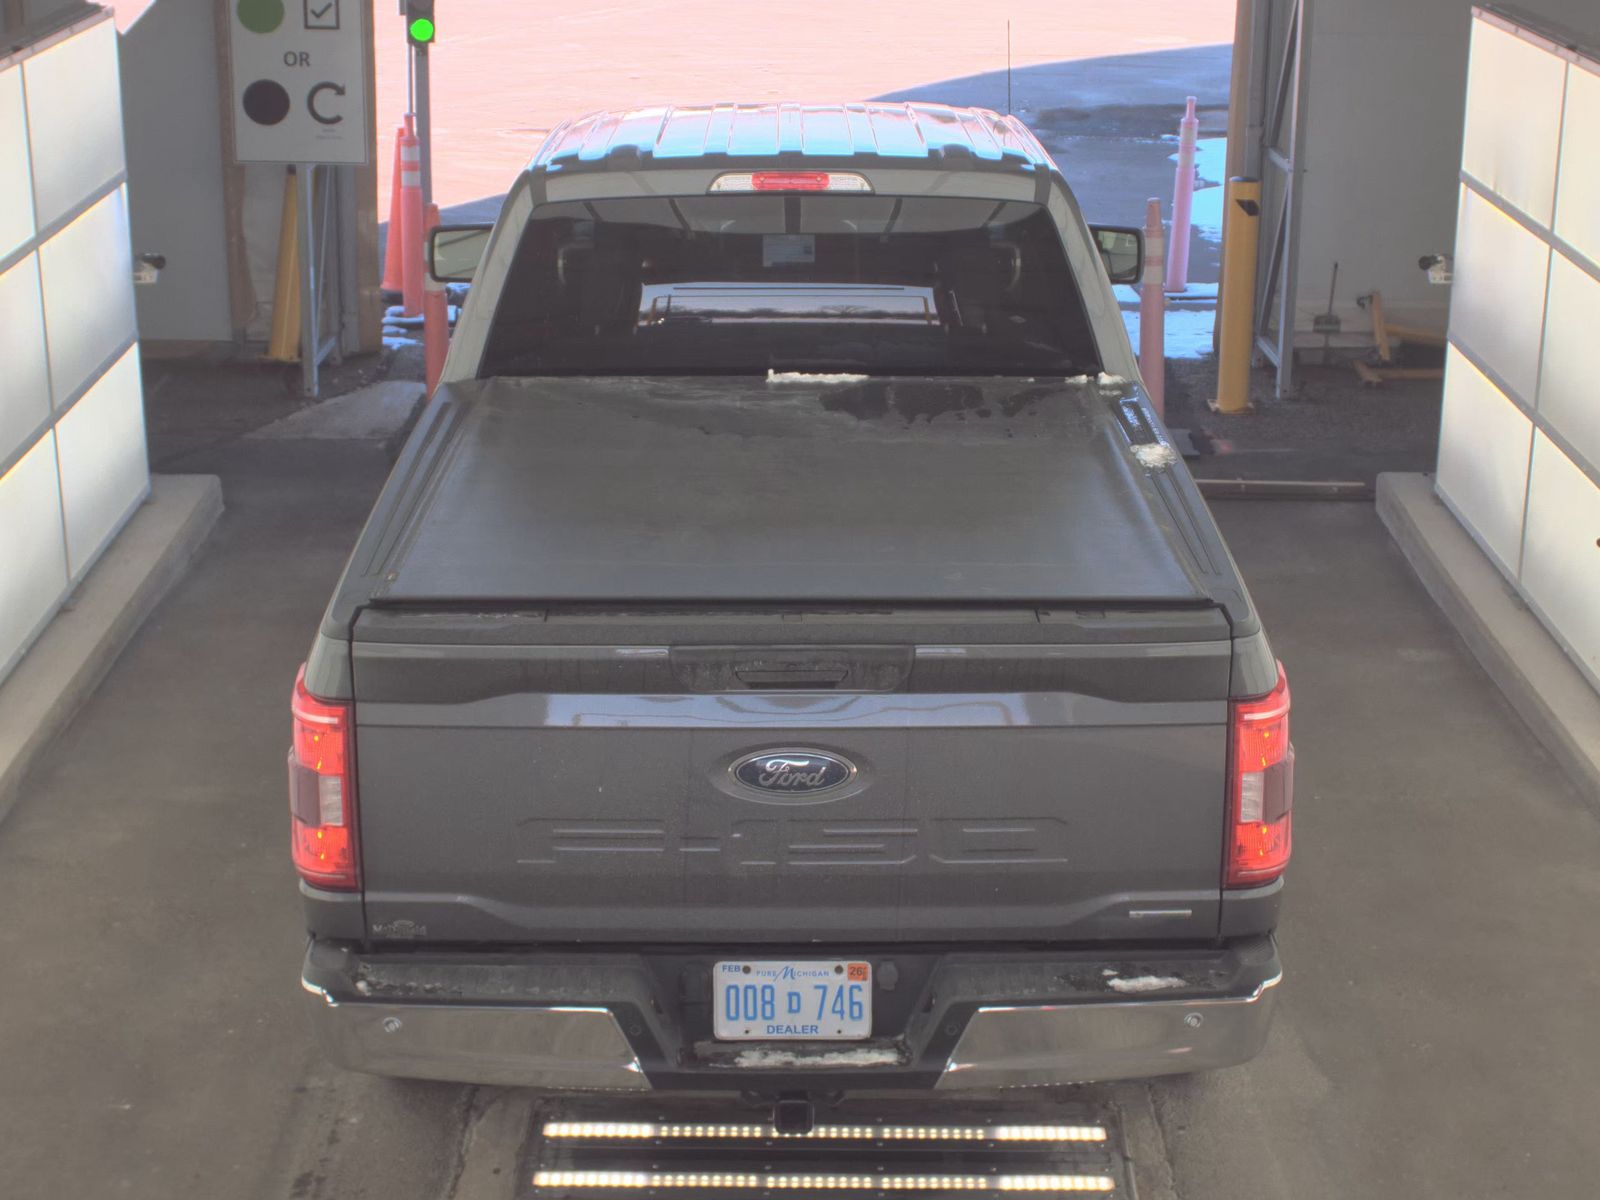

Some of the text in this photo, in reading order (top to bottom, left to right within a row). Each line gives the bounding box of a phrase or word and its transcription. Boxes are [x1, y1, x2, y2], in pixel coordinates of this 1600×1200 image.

[283, 51, 311, 67] OR
[758, 759, 827, 787] Ford
[722, 964, 741, 973] FEB
[850, 966, 863, 976] 26
[725, 984, 864, 1021] 008 D 746
[766, 1024, 819, 1035] DEALER
